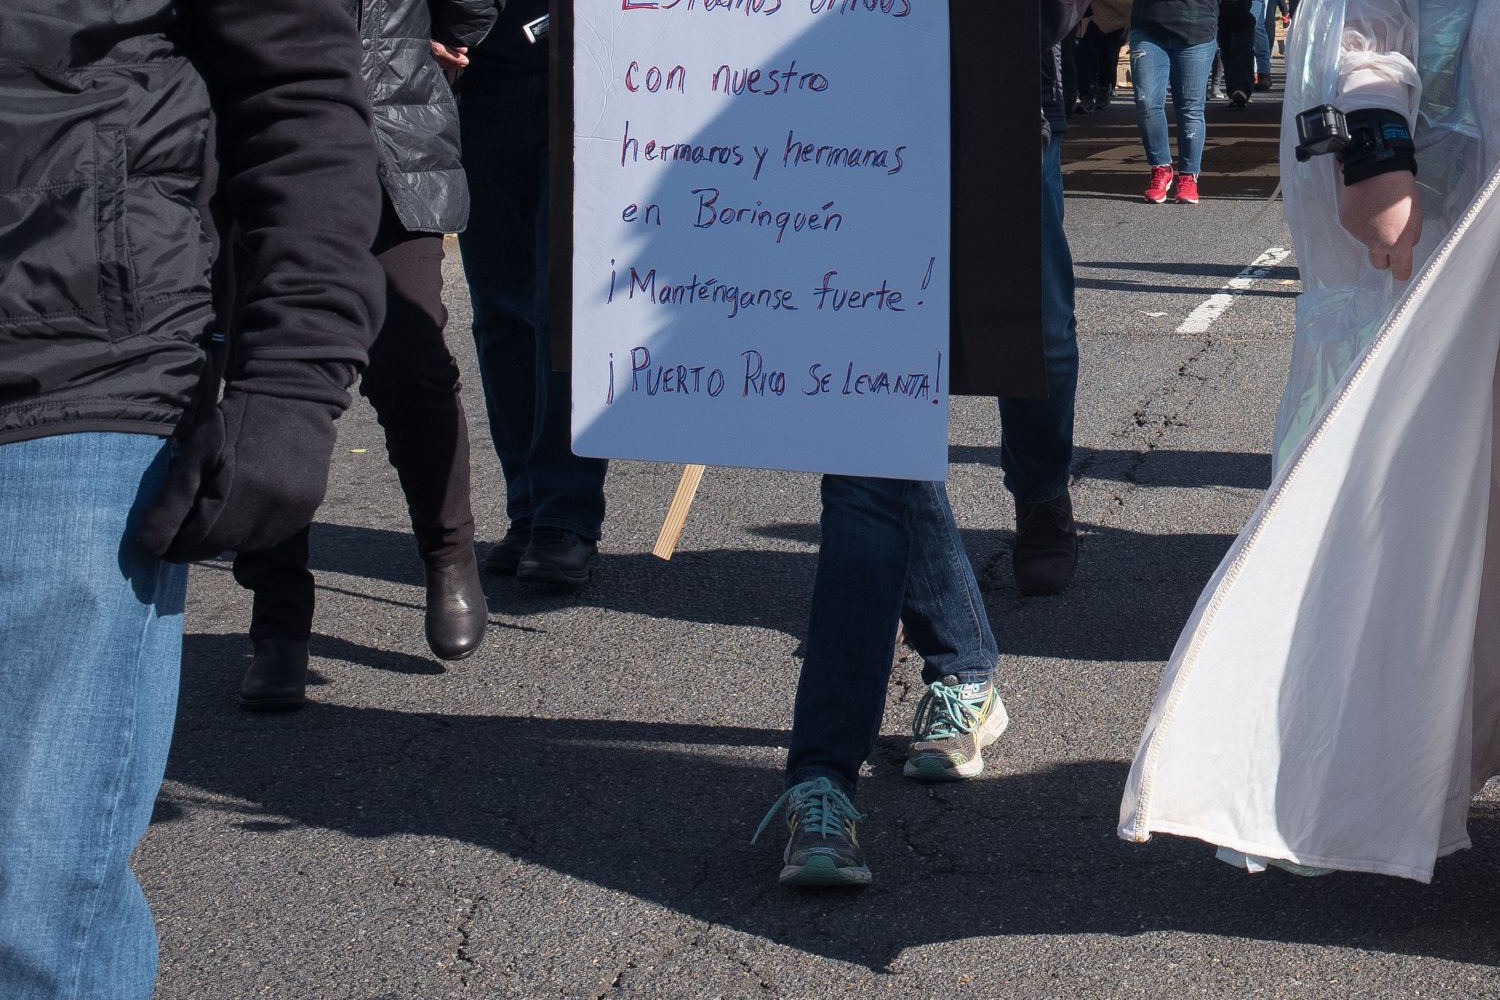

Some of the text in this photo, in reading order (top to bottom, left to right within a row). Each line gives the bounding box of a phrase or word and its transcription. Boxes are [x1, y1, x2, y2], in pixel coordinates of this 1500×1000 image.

[624, 60, 830, 95] con nuestro
[620, 120, 907, 181] hermanos y hermanas
[621, 202, 662, 227] en
